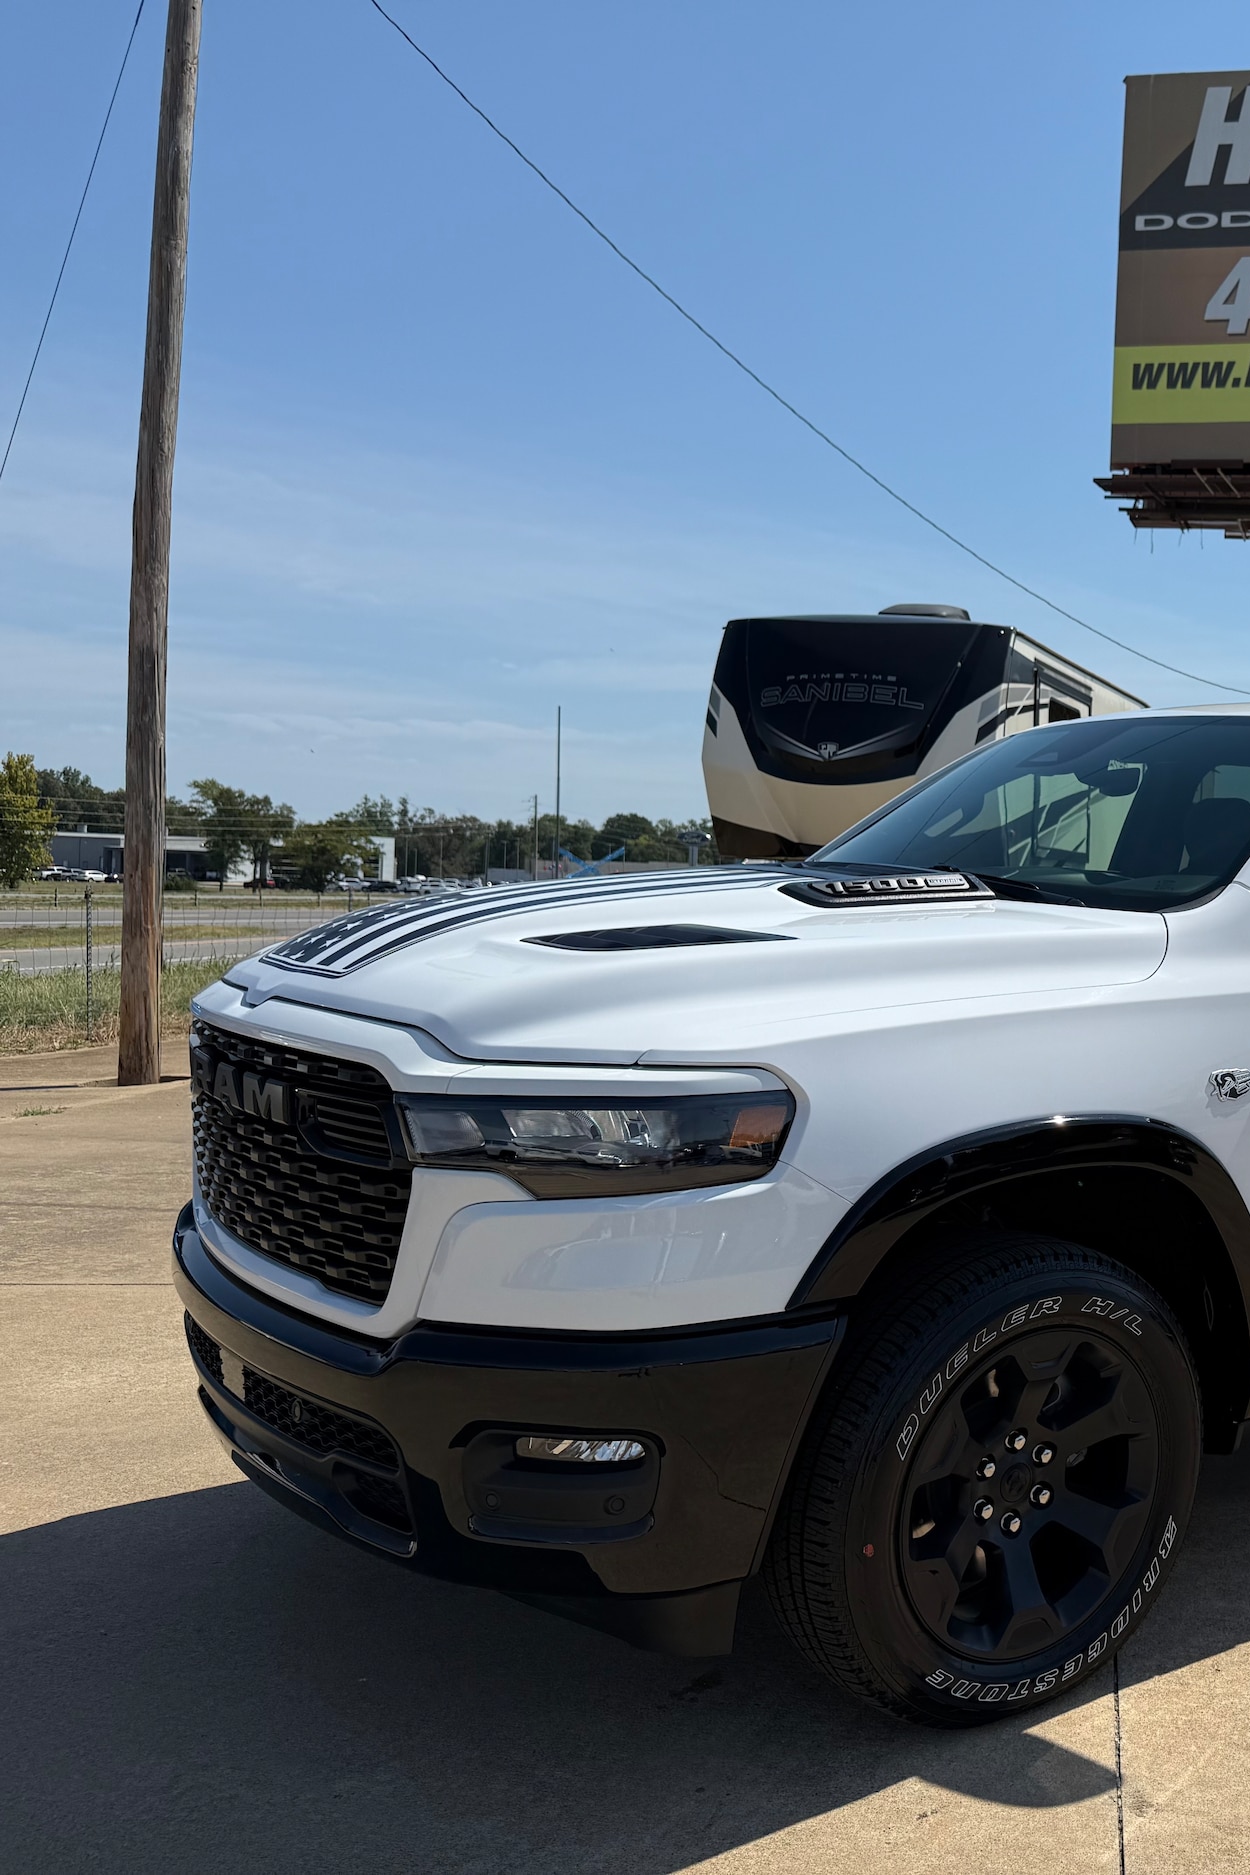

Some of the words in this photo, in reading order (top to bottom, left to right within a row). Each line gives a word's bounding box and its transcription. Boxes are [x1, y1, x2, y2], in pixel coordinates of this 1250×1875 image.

[760, 683, 925, 710] SANIBEL
[825, 875, 926, 895] 1500
[191, 1047, 288, 1126] RAM
[895, 1296, 1063, 1461] DUELER
[1081, 1296, 1144, 1336] H/L
[926, 1515, 1178, 1702] BRIDGESTONE
